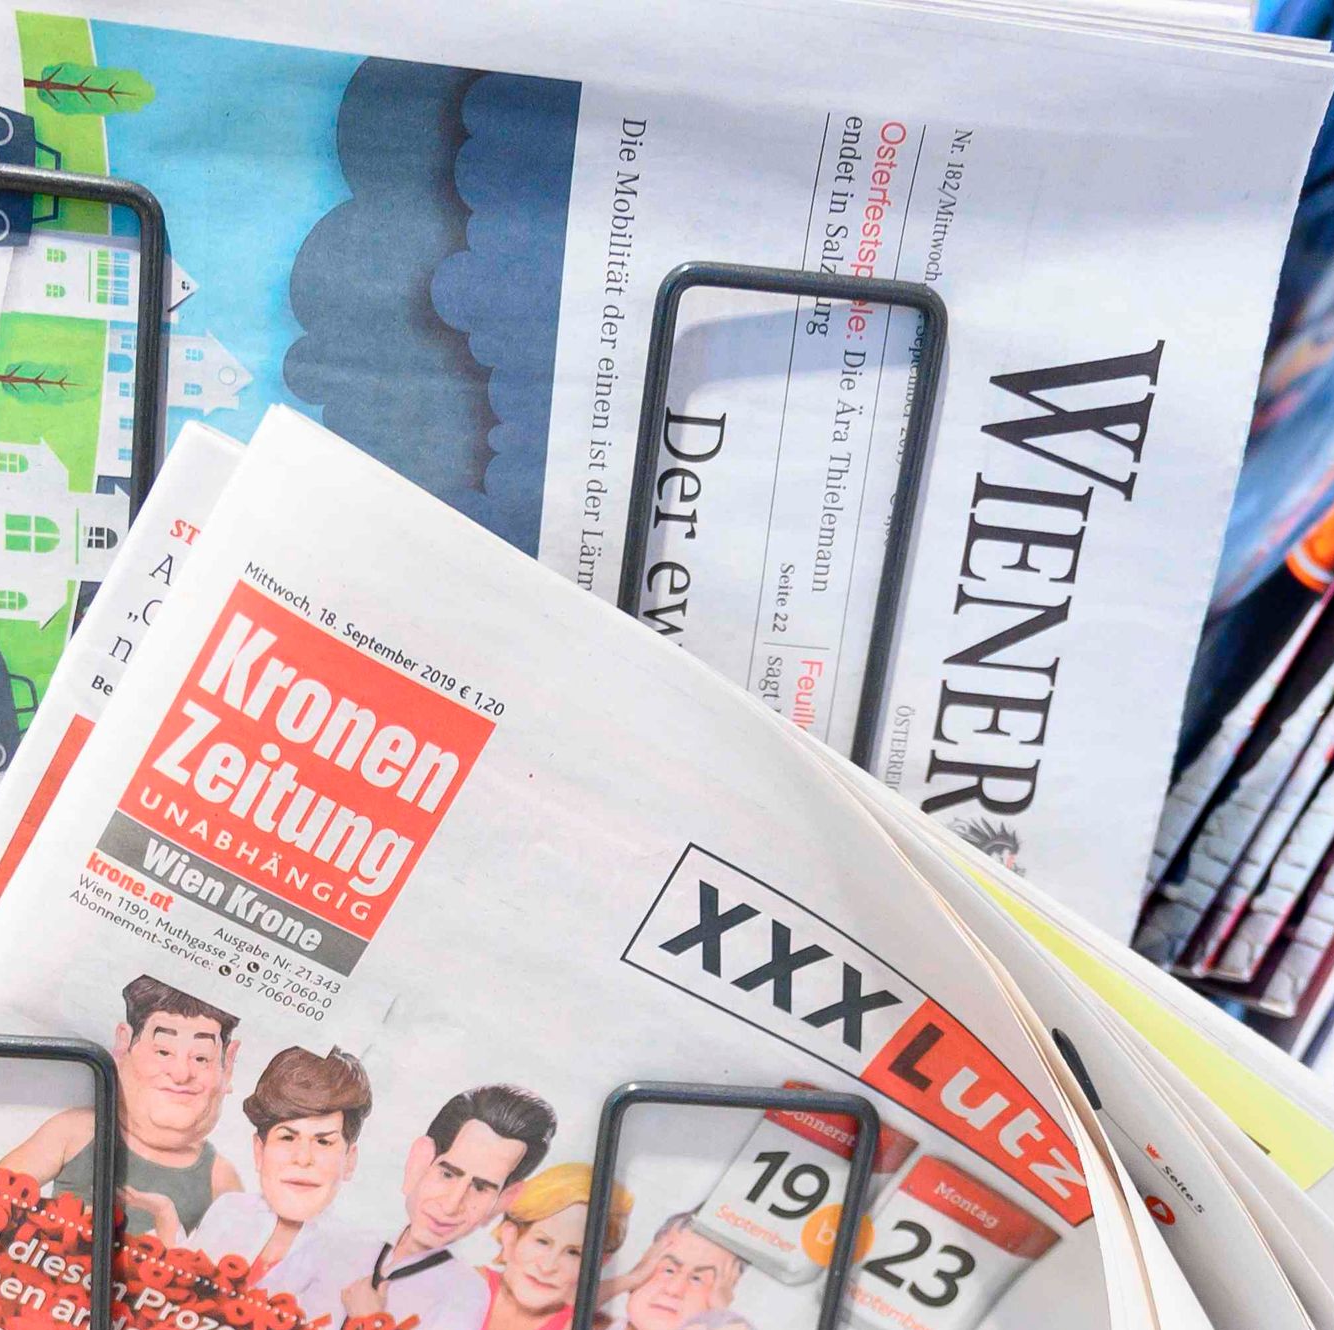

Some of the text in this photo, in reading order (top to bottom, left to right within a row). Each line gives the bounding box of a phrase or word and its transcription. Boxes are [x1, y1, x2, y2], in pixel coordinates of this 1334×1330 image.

[617, 117, 647, 162] Die
[949, 128, 973, 155] Nr.
[604, 170, 640, 295] Mobilität
[804, 115, 863, 338] endet in Salzurg
[599, 304, 625, 349] der
[810, 118, 908, 592] Osterfestspele: Die Ära Thielemann
[591, 357, 619, 429] einen
[587, 439, 612, 471] ist
[653, 406, 727, 540] Der
[583, 478, 608, 521] der
[771, 562, 795, 633] Seite 22
[920, 339, 1165, 817] WIENER
[243, 561, 505, 717] Mittwoch, 18. September 2019 € 1,20
[758, 654, 784, 699] sagt
[199, 614, 461, 813] Kronen
[152, 704, 416, 896] Zeitung
[86, 852, 174, 912] krone.at
[138, 786, 371, 921] UNABHÄNGIG
[141, 838, 323, 952] Wien Krone
[69, 888, 325, 1023] Abonnement-Service: 05 7060-600
[78, 872, 332, 1009] Wien 1190, Muthgasse 2, 05 7060-0
[213, 925, 341, 995] Ausgabe Nr. 21.343
[743, 1146, 832, 1224] 19
[932, 1179, 999, 1229] Montag
[1162, 1166, 1194, 1202] Seite
[863, 1216, 977, 1311] 23
